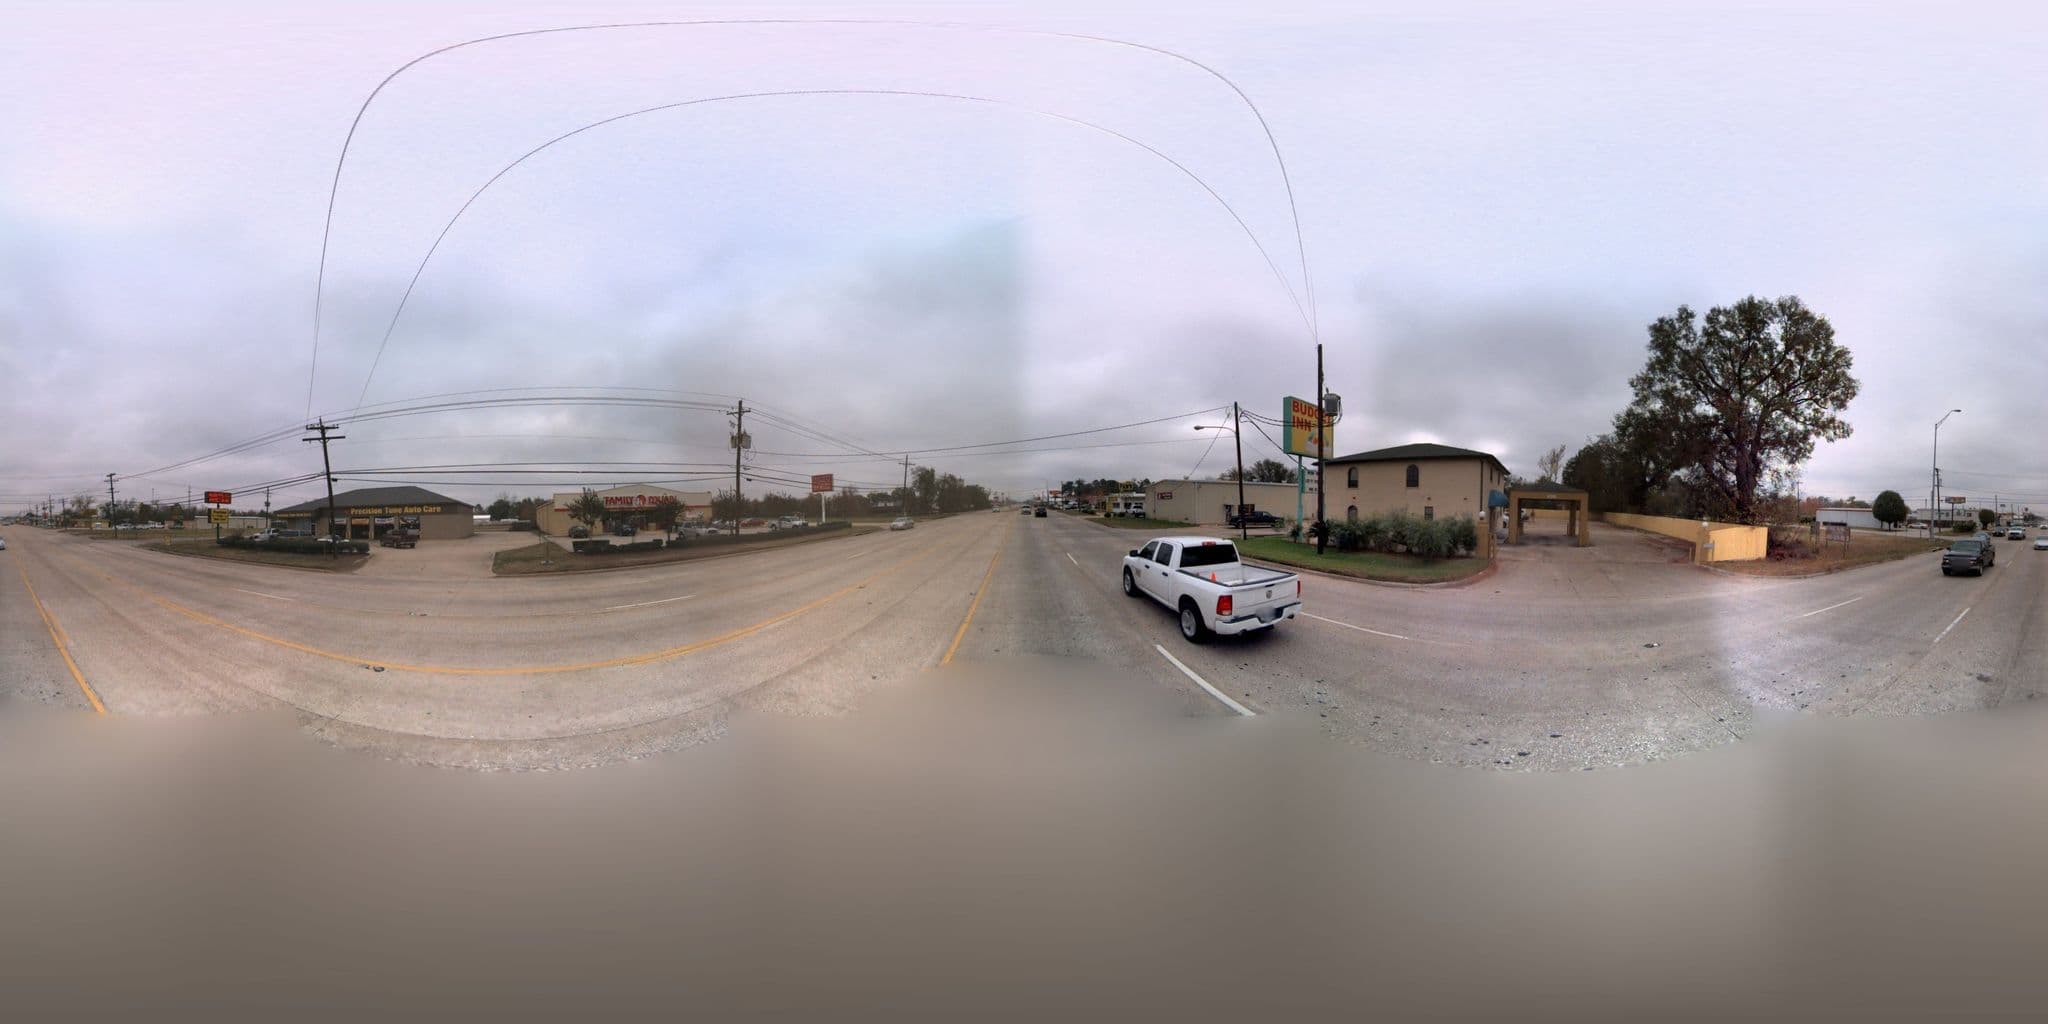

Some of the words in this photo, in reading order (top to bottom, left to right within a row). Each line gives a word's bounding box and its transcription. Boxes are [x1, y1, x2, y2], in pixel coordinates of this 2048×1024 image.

[1292, 415, 1312, 432] INN
[605, 496, 633, 505] FAMILY
[351, 507, 382, 515] Precision
